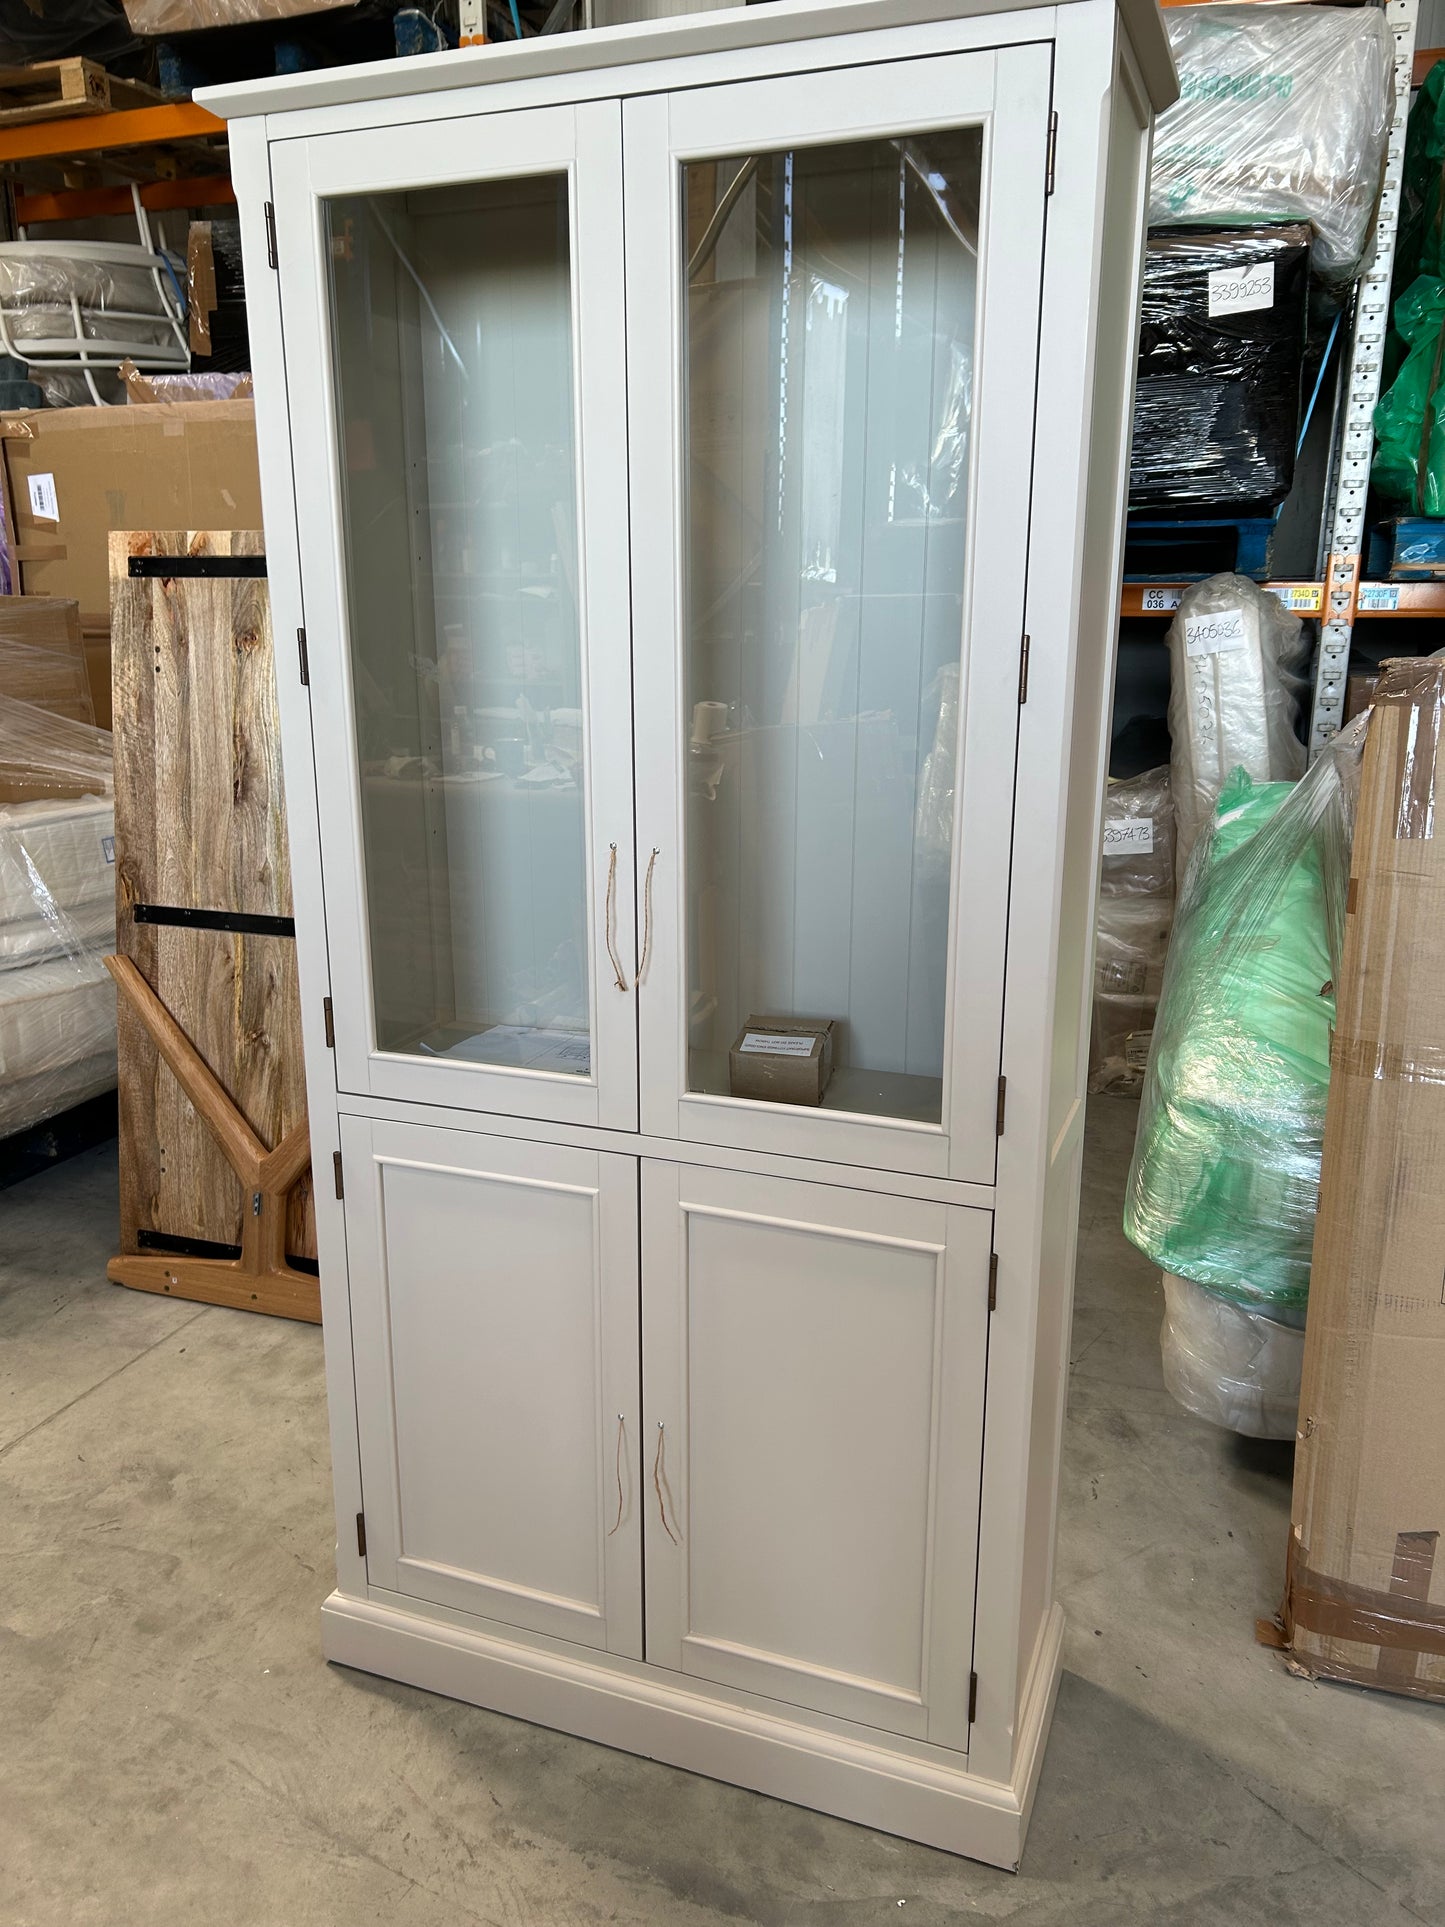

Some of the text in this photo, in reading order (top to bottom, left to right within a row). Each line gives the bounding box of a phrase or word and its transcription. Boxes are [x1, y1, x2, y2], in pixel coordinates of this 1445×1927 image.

[1211, 276, 1272, 303] 3399253
[1148, 590, 1164, 599] CC
[1146, 600, 1165, 609] 036
[1187, 619, 1241, 645] 3405036
